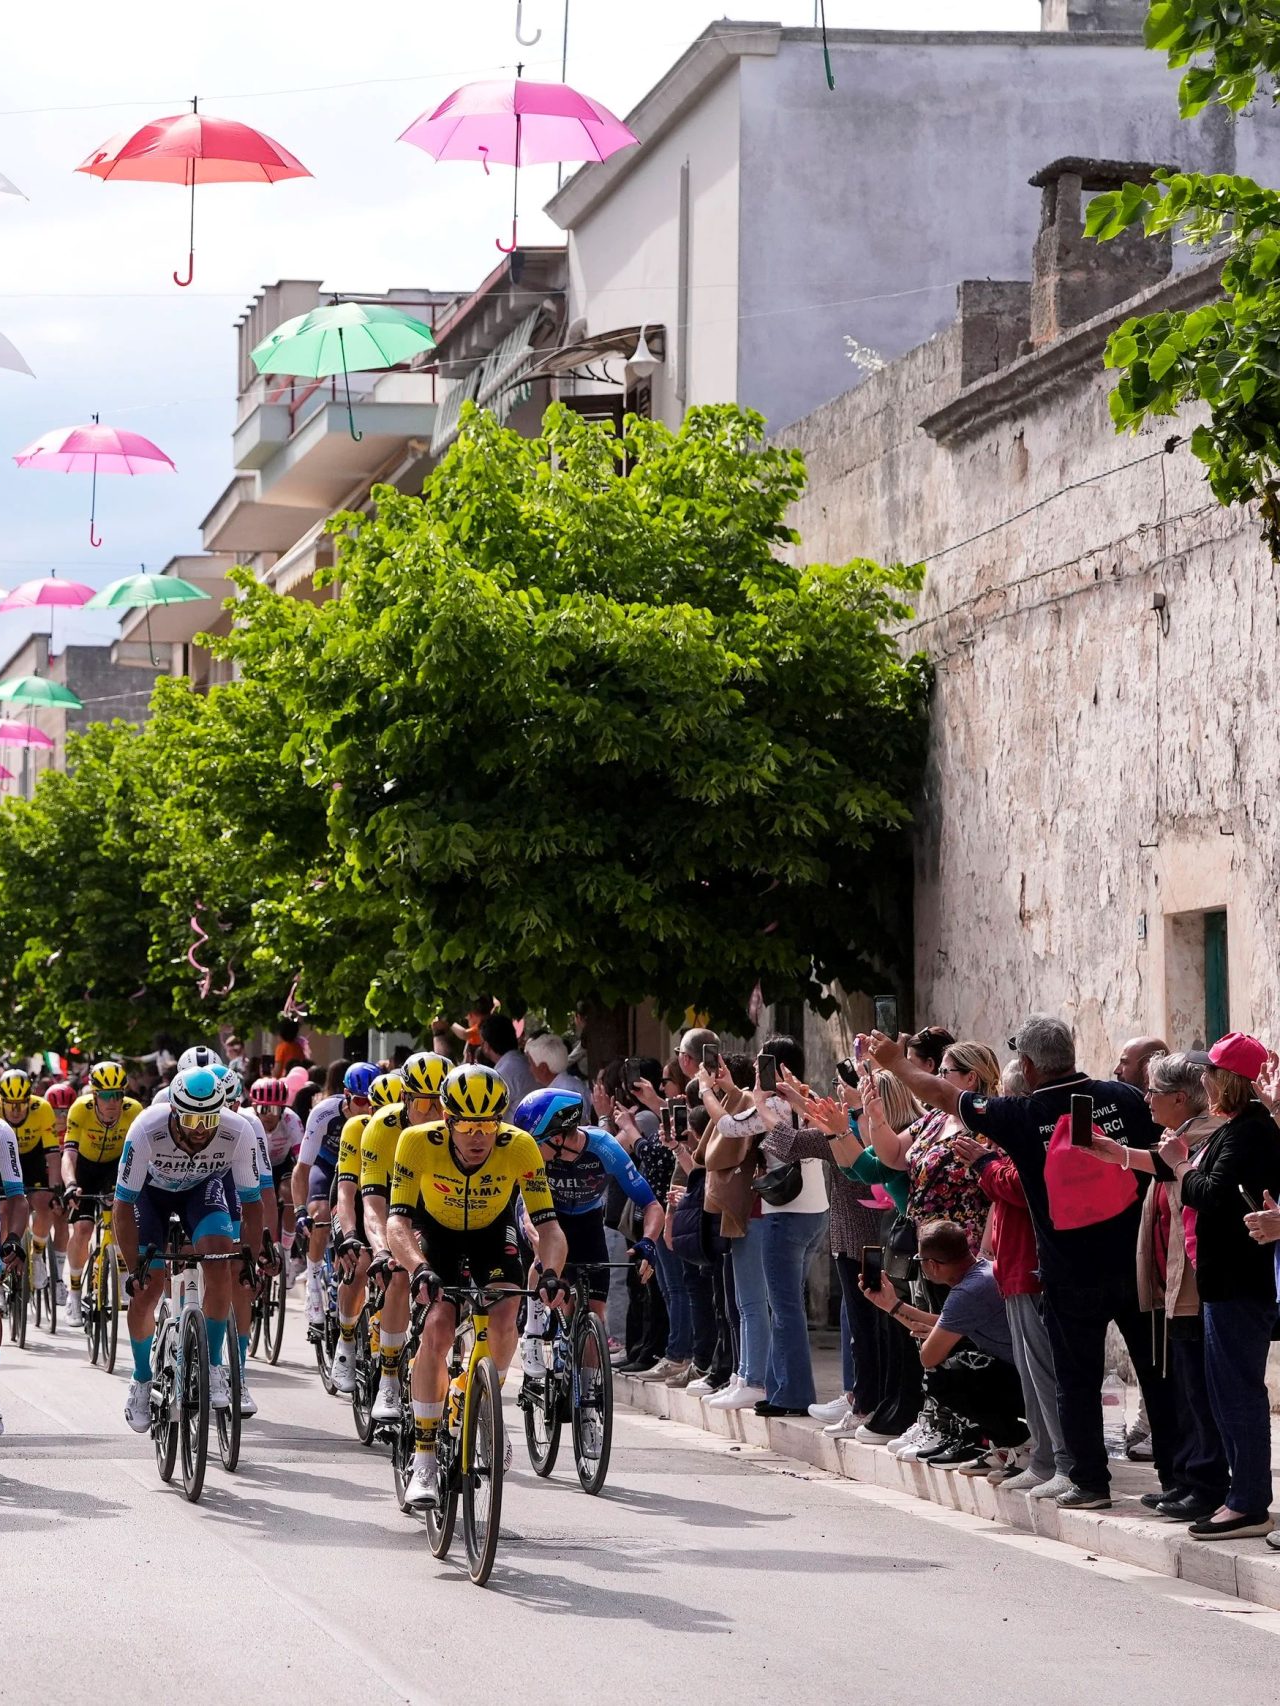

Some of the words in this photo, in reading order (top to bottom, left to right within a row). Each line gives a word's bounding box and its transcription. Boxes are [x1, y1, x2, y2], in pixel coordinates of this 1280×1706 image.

[1092, 1104, 1118, 1119] CIVILE
[7, 1141, 20, 1178] MERIDA
[122, 1147, 135, 1184] MERIDA
[154, 1160, 226, 1169] BAHRAIN
[455, 1187, 501, 1197] VISMA
[533, 1211, 557, 1222] SRAM
